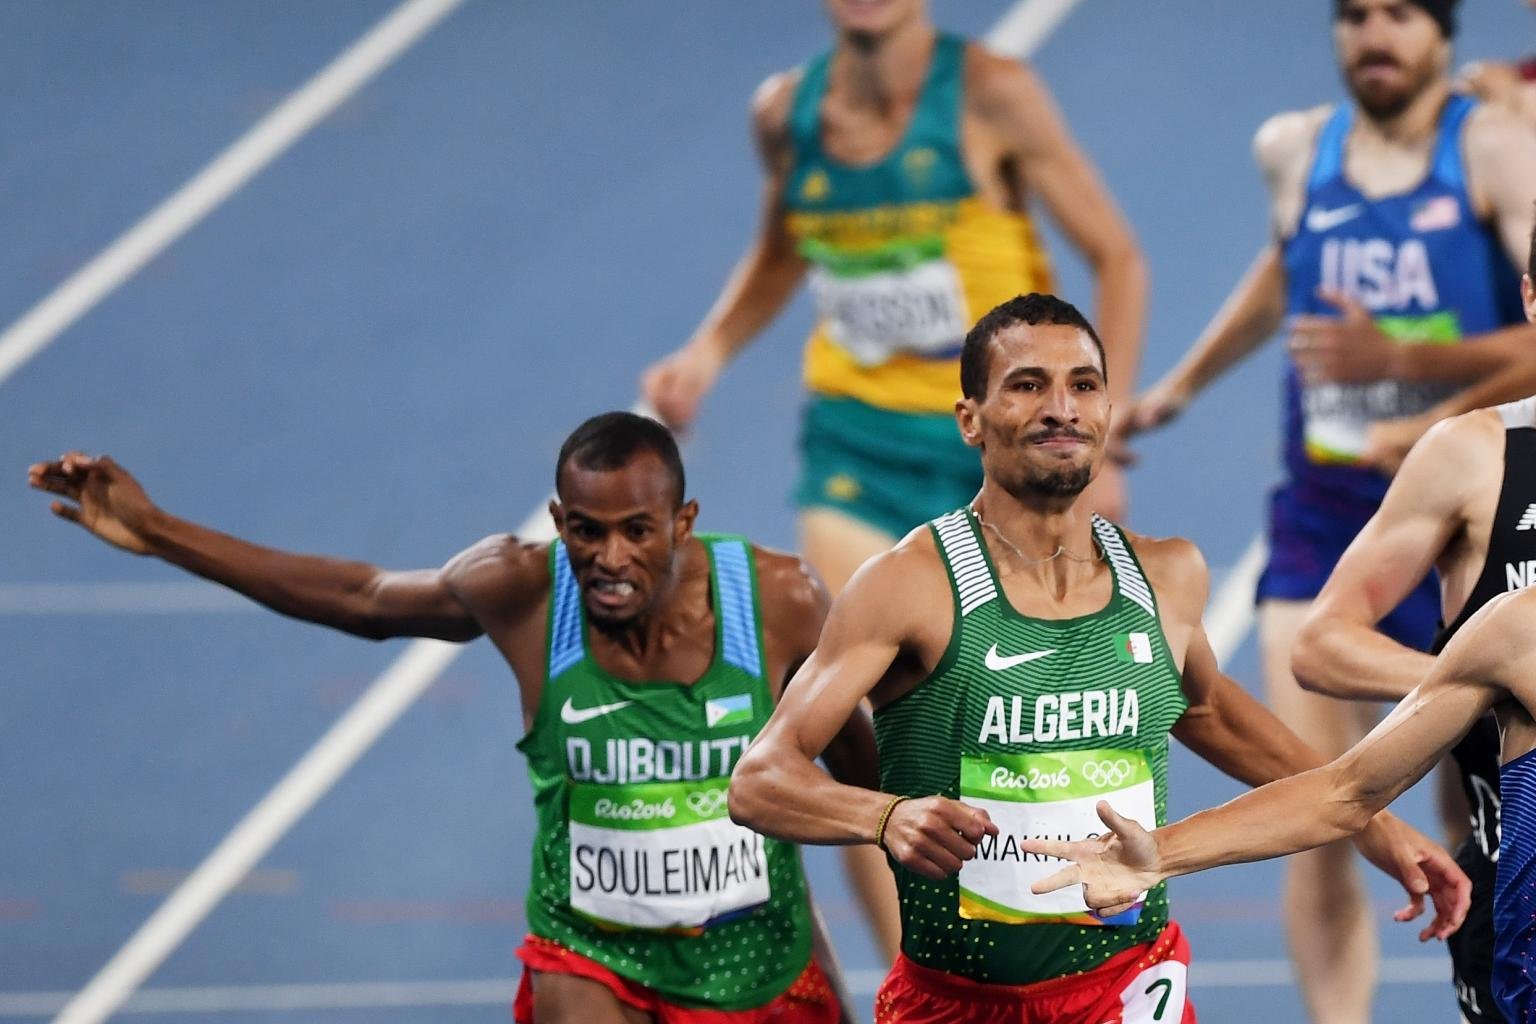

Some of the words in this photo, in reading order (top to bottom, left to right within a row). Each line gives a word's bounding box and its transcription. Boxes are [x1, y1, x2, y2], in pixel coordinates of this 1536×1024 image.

[1320, 239, 1440, 312] USA
[979, 688, 1139, 744] ALGERIA
[990, 766, 1070, 788] Rio2016
[575, 836, 762, 898] SOULEIMAN
[1145, 977, 1172, 1022] 7
